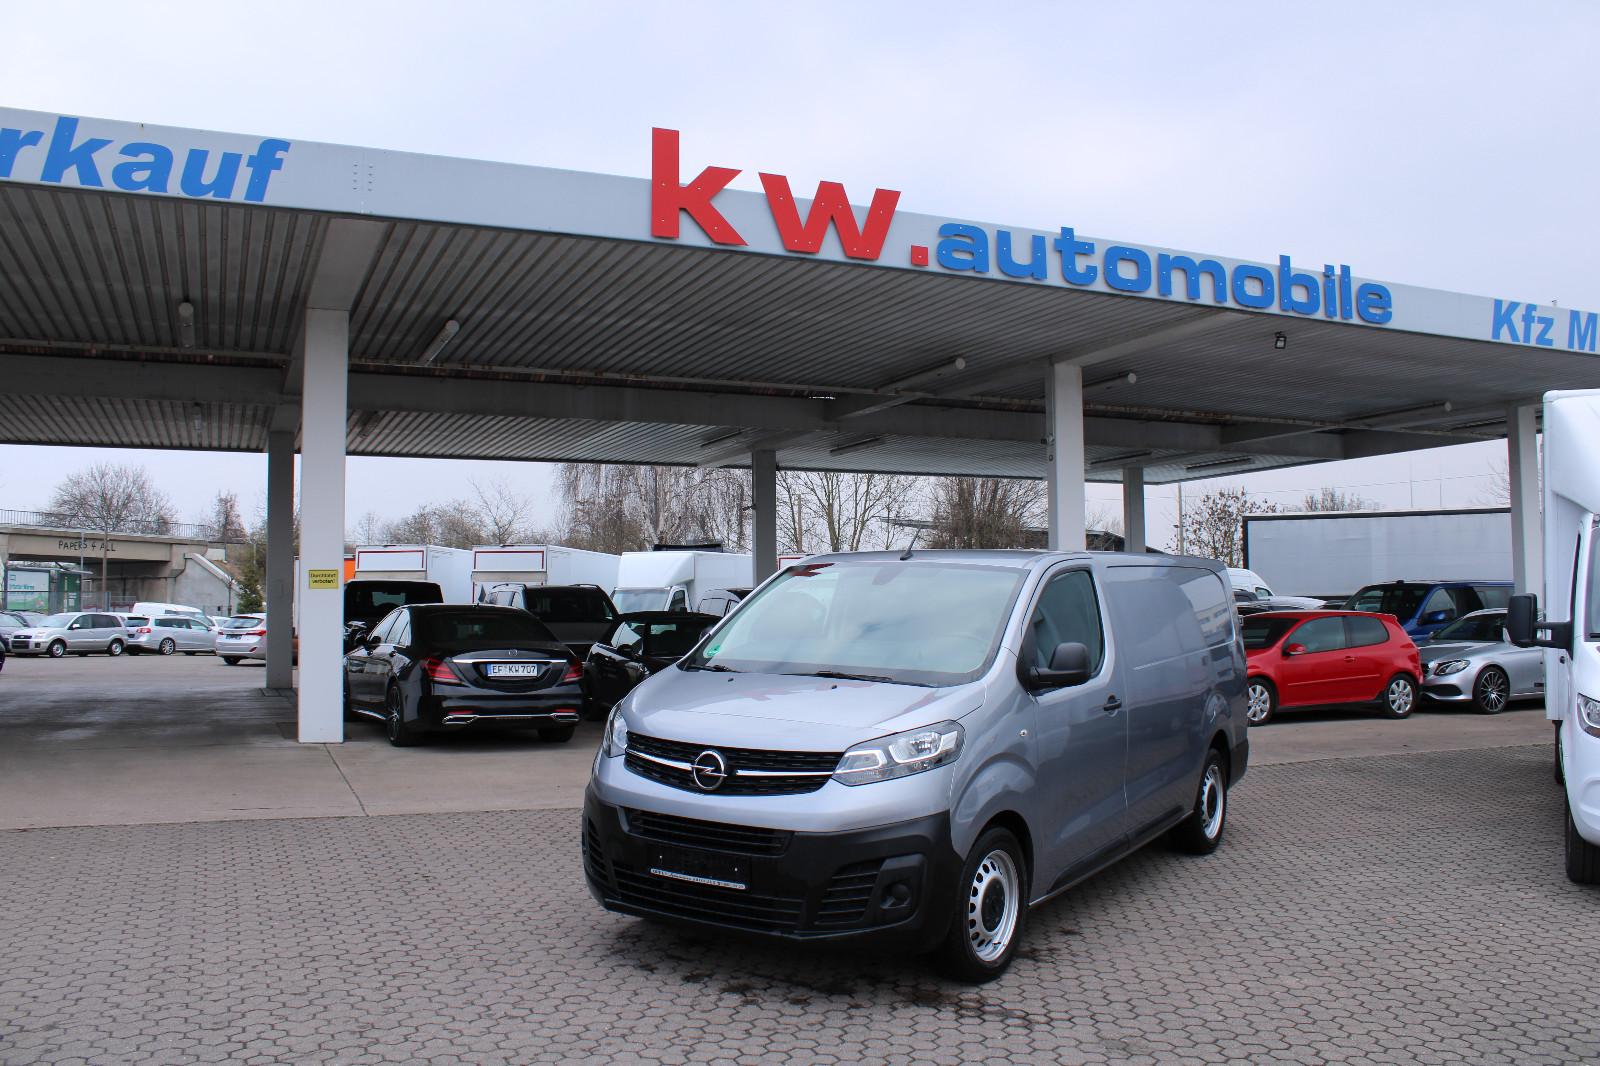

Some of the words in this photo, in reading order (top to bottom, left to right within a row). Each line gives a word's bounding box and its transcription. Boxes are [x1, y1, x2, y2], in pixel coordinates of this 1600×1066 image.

[0, 116, 291, 202] rkauf
[937, 222, 1393, 325] automobile
[1491, 298, 1555, 347] Kfz
